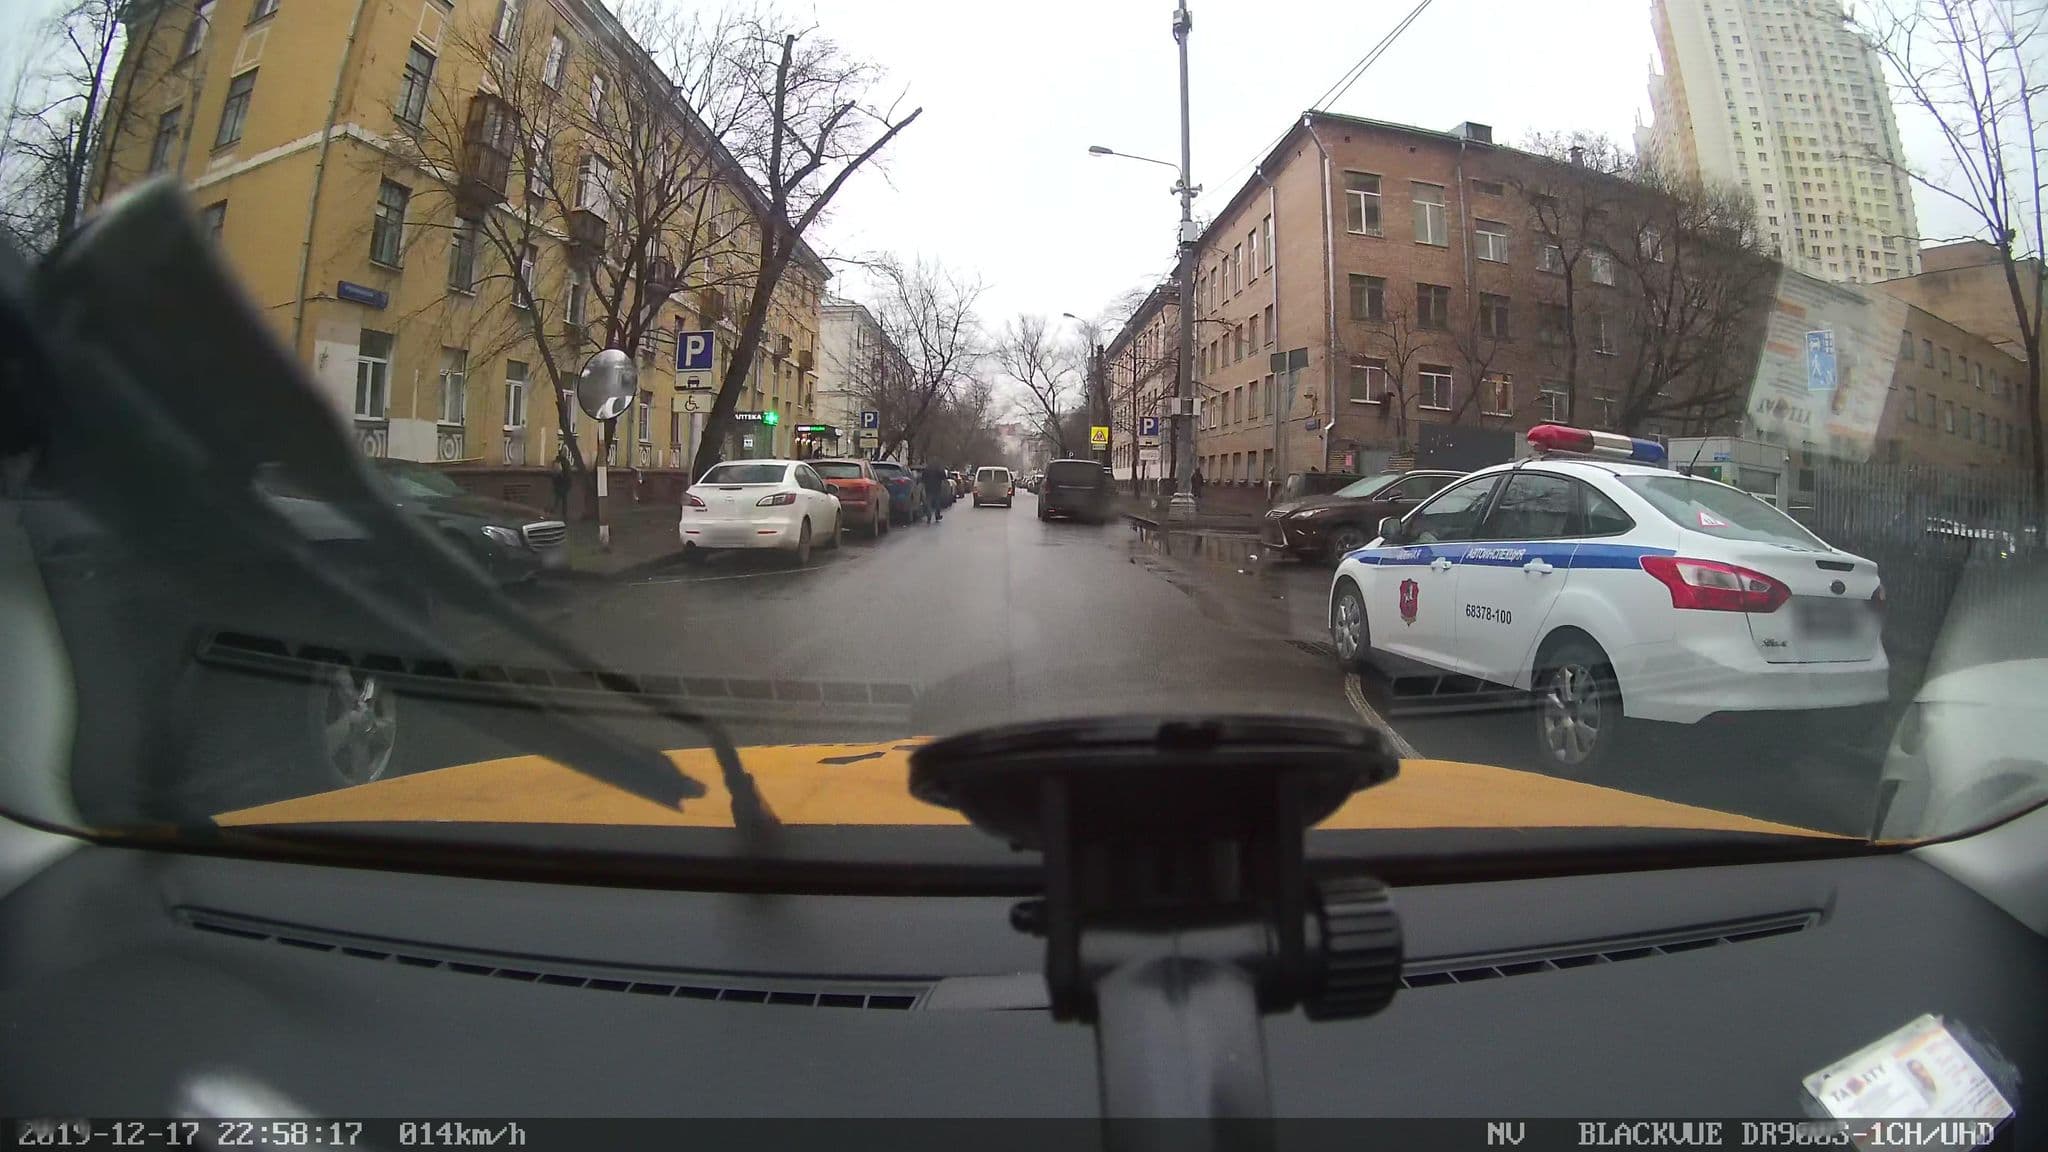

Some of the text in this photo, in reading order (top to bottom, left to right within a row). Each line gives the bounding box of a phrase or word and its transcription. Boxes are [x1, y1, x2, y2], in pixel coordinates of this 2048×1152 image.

[686, 335, 705, 367] P
[864, 412, 874, 427] P
[1143, 417, 1155, 434] P
[1466, 603, 1512, 624] 68378-100
